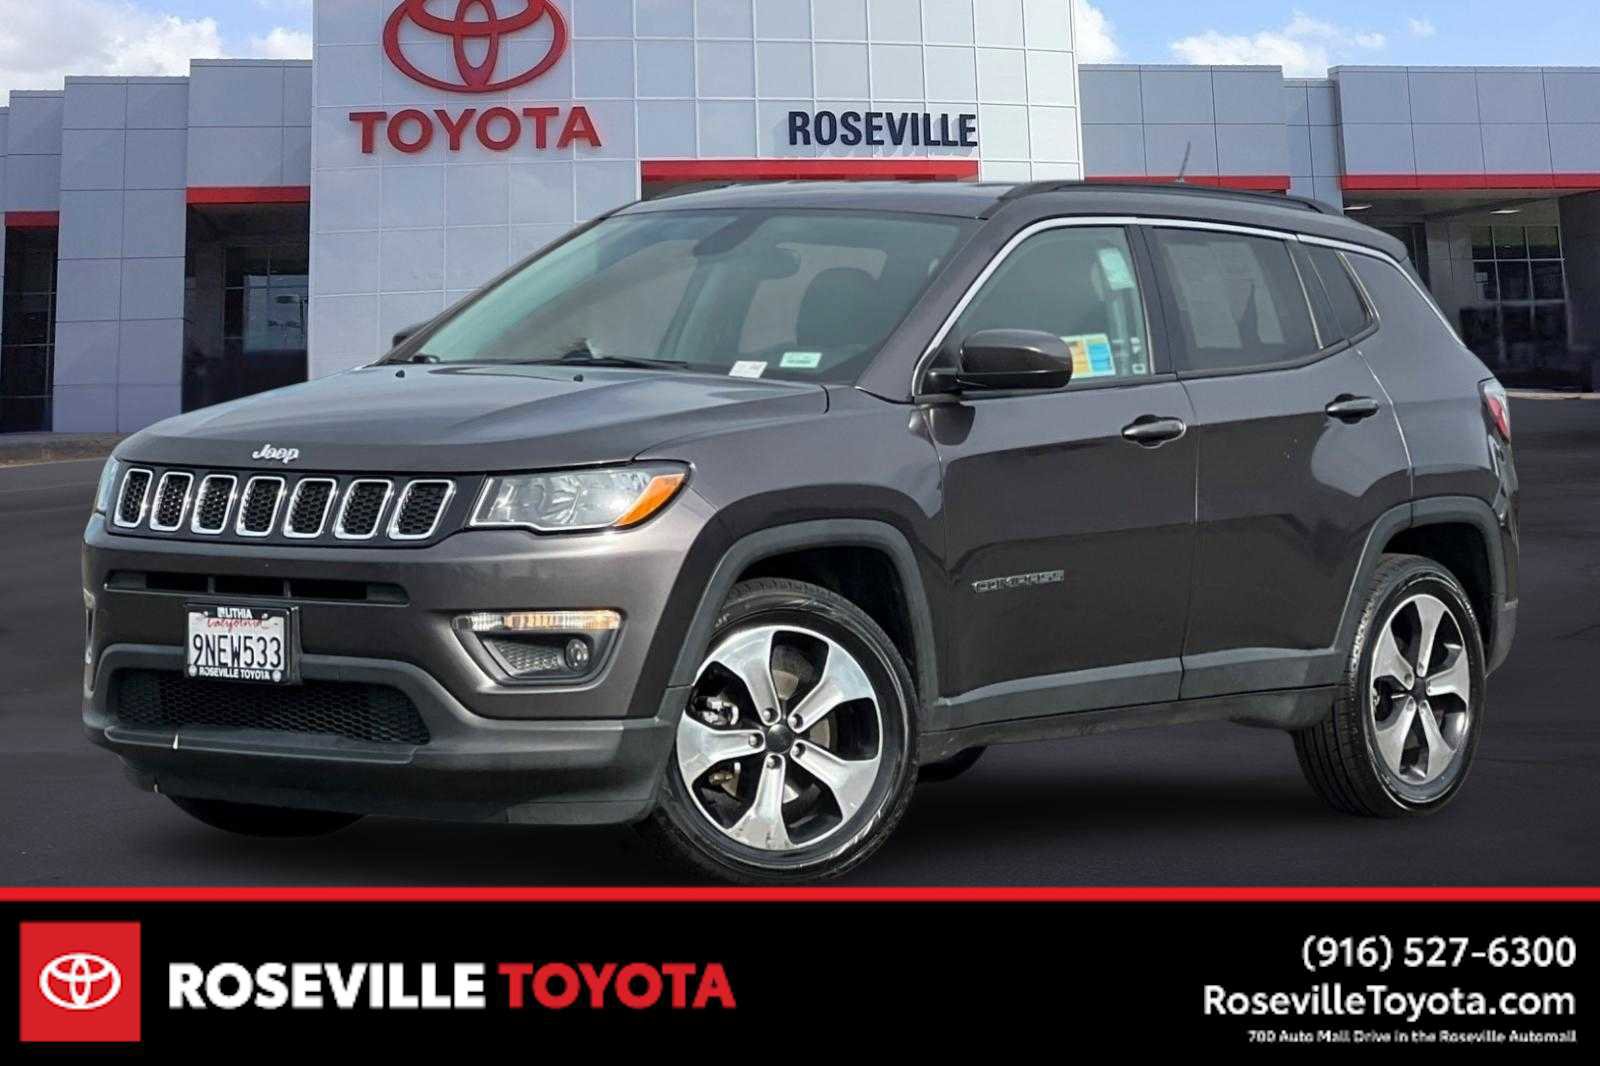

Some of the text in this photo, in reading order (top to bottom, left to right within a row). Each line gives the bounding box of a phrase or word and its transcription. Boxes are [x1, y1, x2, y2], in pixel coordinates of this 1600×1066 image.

[349, 106, 602, 154] TOYOTA
[788, 110, 978, 147] ROSEVILLE
[252, 444, 299, 464] Jeep
[226, 608, 253, 619] LITHIA
[192, 633, 282, 669] 9NEW533
[198, 667, 271, 681] ROSEVILLE TOYOTA
